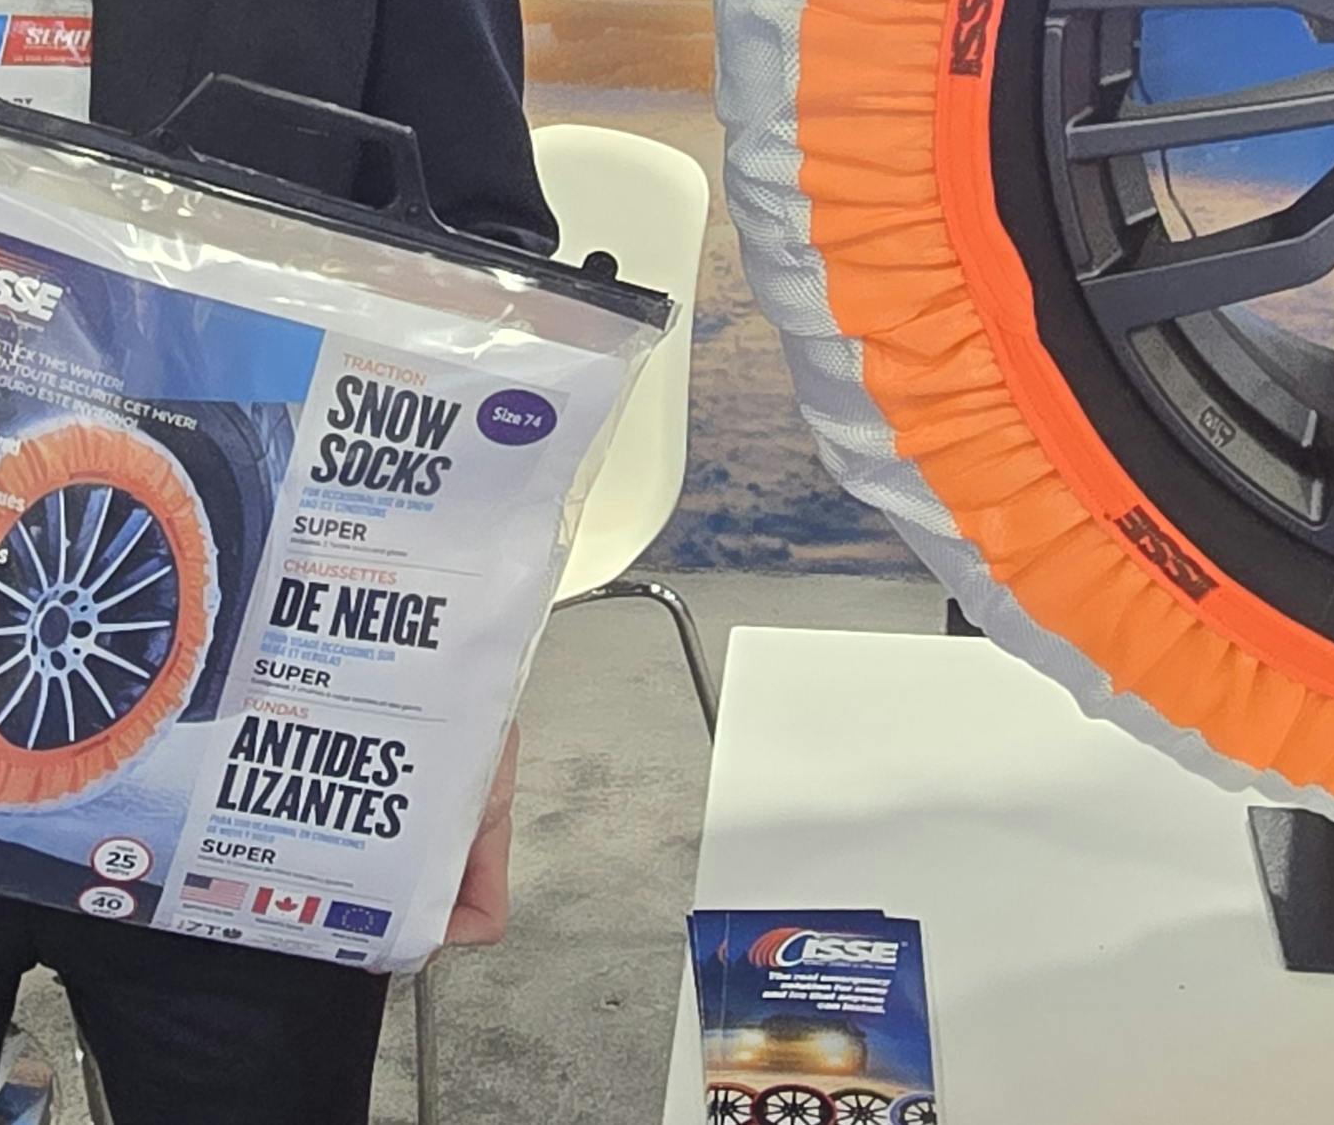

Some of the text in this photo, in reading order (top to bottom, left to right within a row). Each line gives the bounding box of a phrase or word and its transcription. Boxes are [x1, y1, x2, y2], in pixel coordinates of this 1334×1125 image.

[38, 351, 69, 374] THIS
[70, 363, 124, 391] WINTER!
[342, 353, 427, 386] TRACTION
[14, 363, 58, 389] TOUTE
[123, 400, 152, 419] CET
[152, 406, 198, 431] HIVER!
[37, 386, 72, 409] ESTE
[327, 375, 462, 450] SNOW
[492, 406, 543, 428] Size 74
[310, 433, 452, 496] SOCKS
[293, 515, 367, 541] SUPER
[1114, 505, 1220, 604] ISSE
[283, 559, 397, 586] CHAUSSETTES
[269, 576, 447, 650] DE NEIGE
[253, 659, 331, 688] SUPER
[242, 696, 310, 719] FUNDAS
[229, 716, 414, 787] ANTIDES-
[216, 764, 408, 839] LIZANTES
[105, 851, 137, 869] 25
[200, 839, 276, 864] SUPER
[91, 896, 122, 910] 40
[802, 938, 899, 964] ISSE
